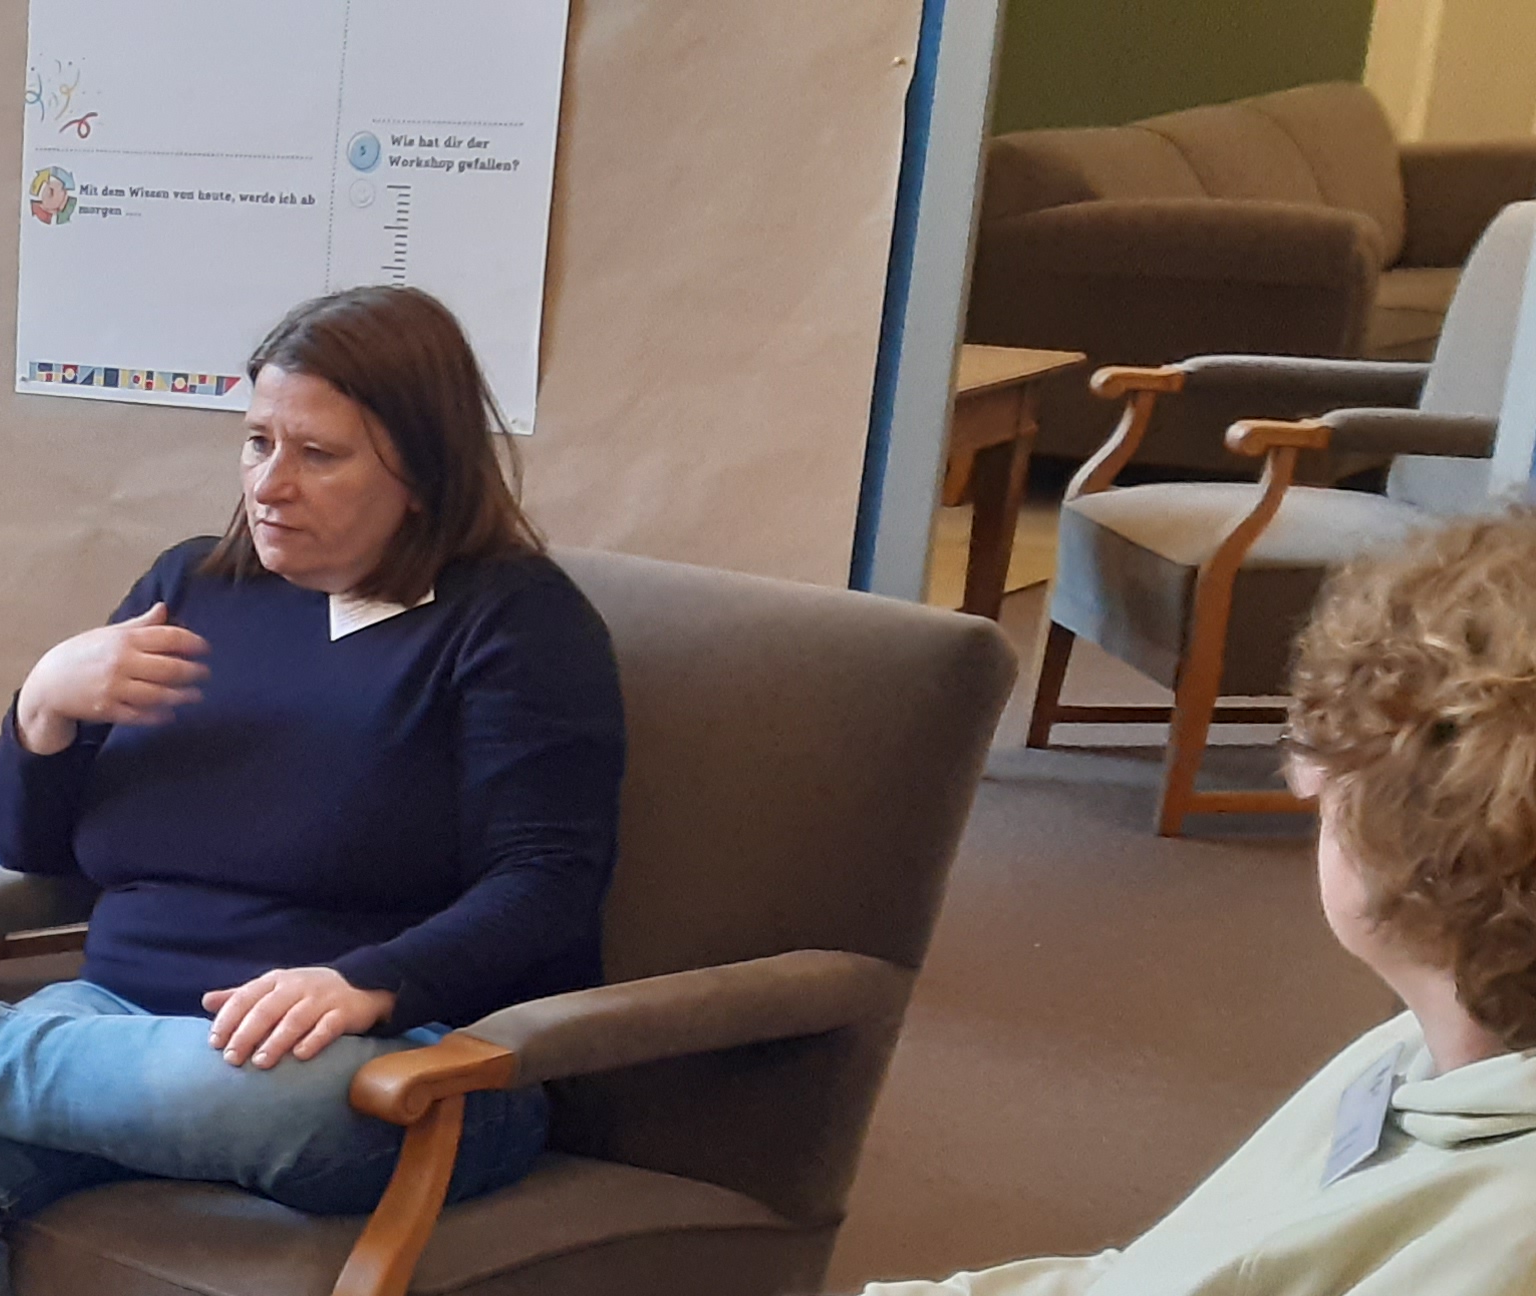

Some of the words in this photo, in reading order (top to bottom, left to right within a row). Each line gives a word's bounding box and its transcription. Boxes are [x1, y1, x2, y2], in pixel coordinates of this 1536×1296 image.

[391, 134, 415, 147] Wie
[418, 135, 439, 148] hat
[444, 136, 464, 148] dir
[467, 137, 490, 149] der
[388, 155, 454, 172] Workshop
[457, 158, 520, 173] gefallen?
[79, 184, 98, 197] Mit
[102, 185, 125, 198] dem
[130, 186, 169, 199] Wissen
[173, 190, 194, 200] von
[198, 189, 236, 203] heute,
[239, 192, 276, 205] werde
[279, 192, 297, 205] ich
[301, 194, 316, 205] ab
[79, 206, 122, 218] morgen
